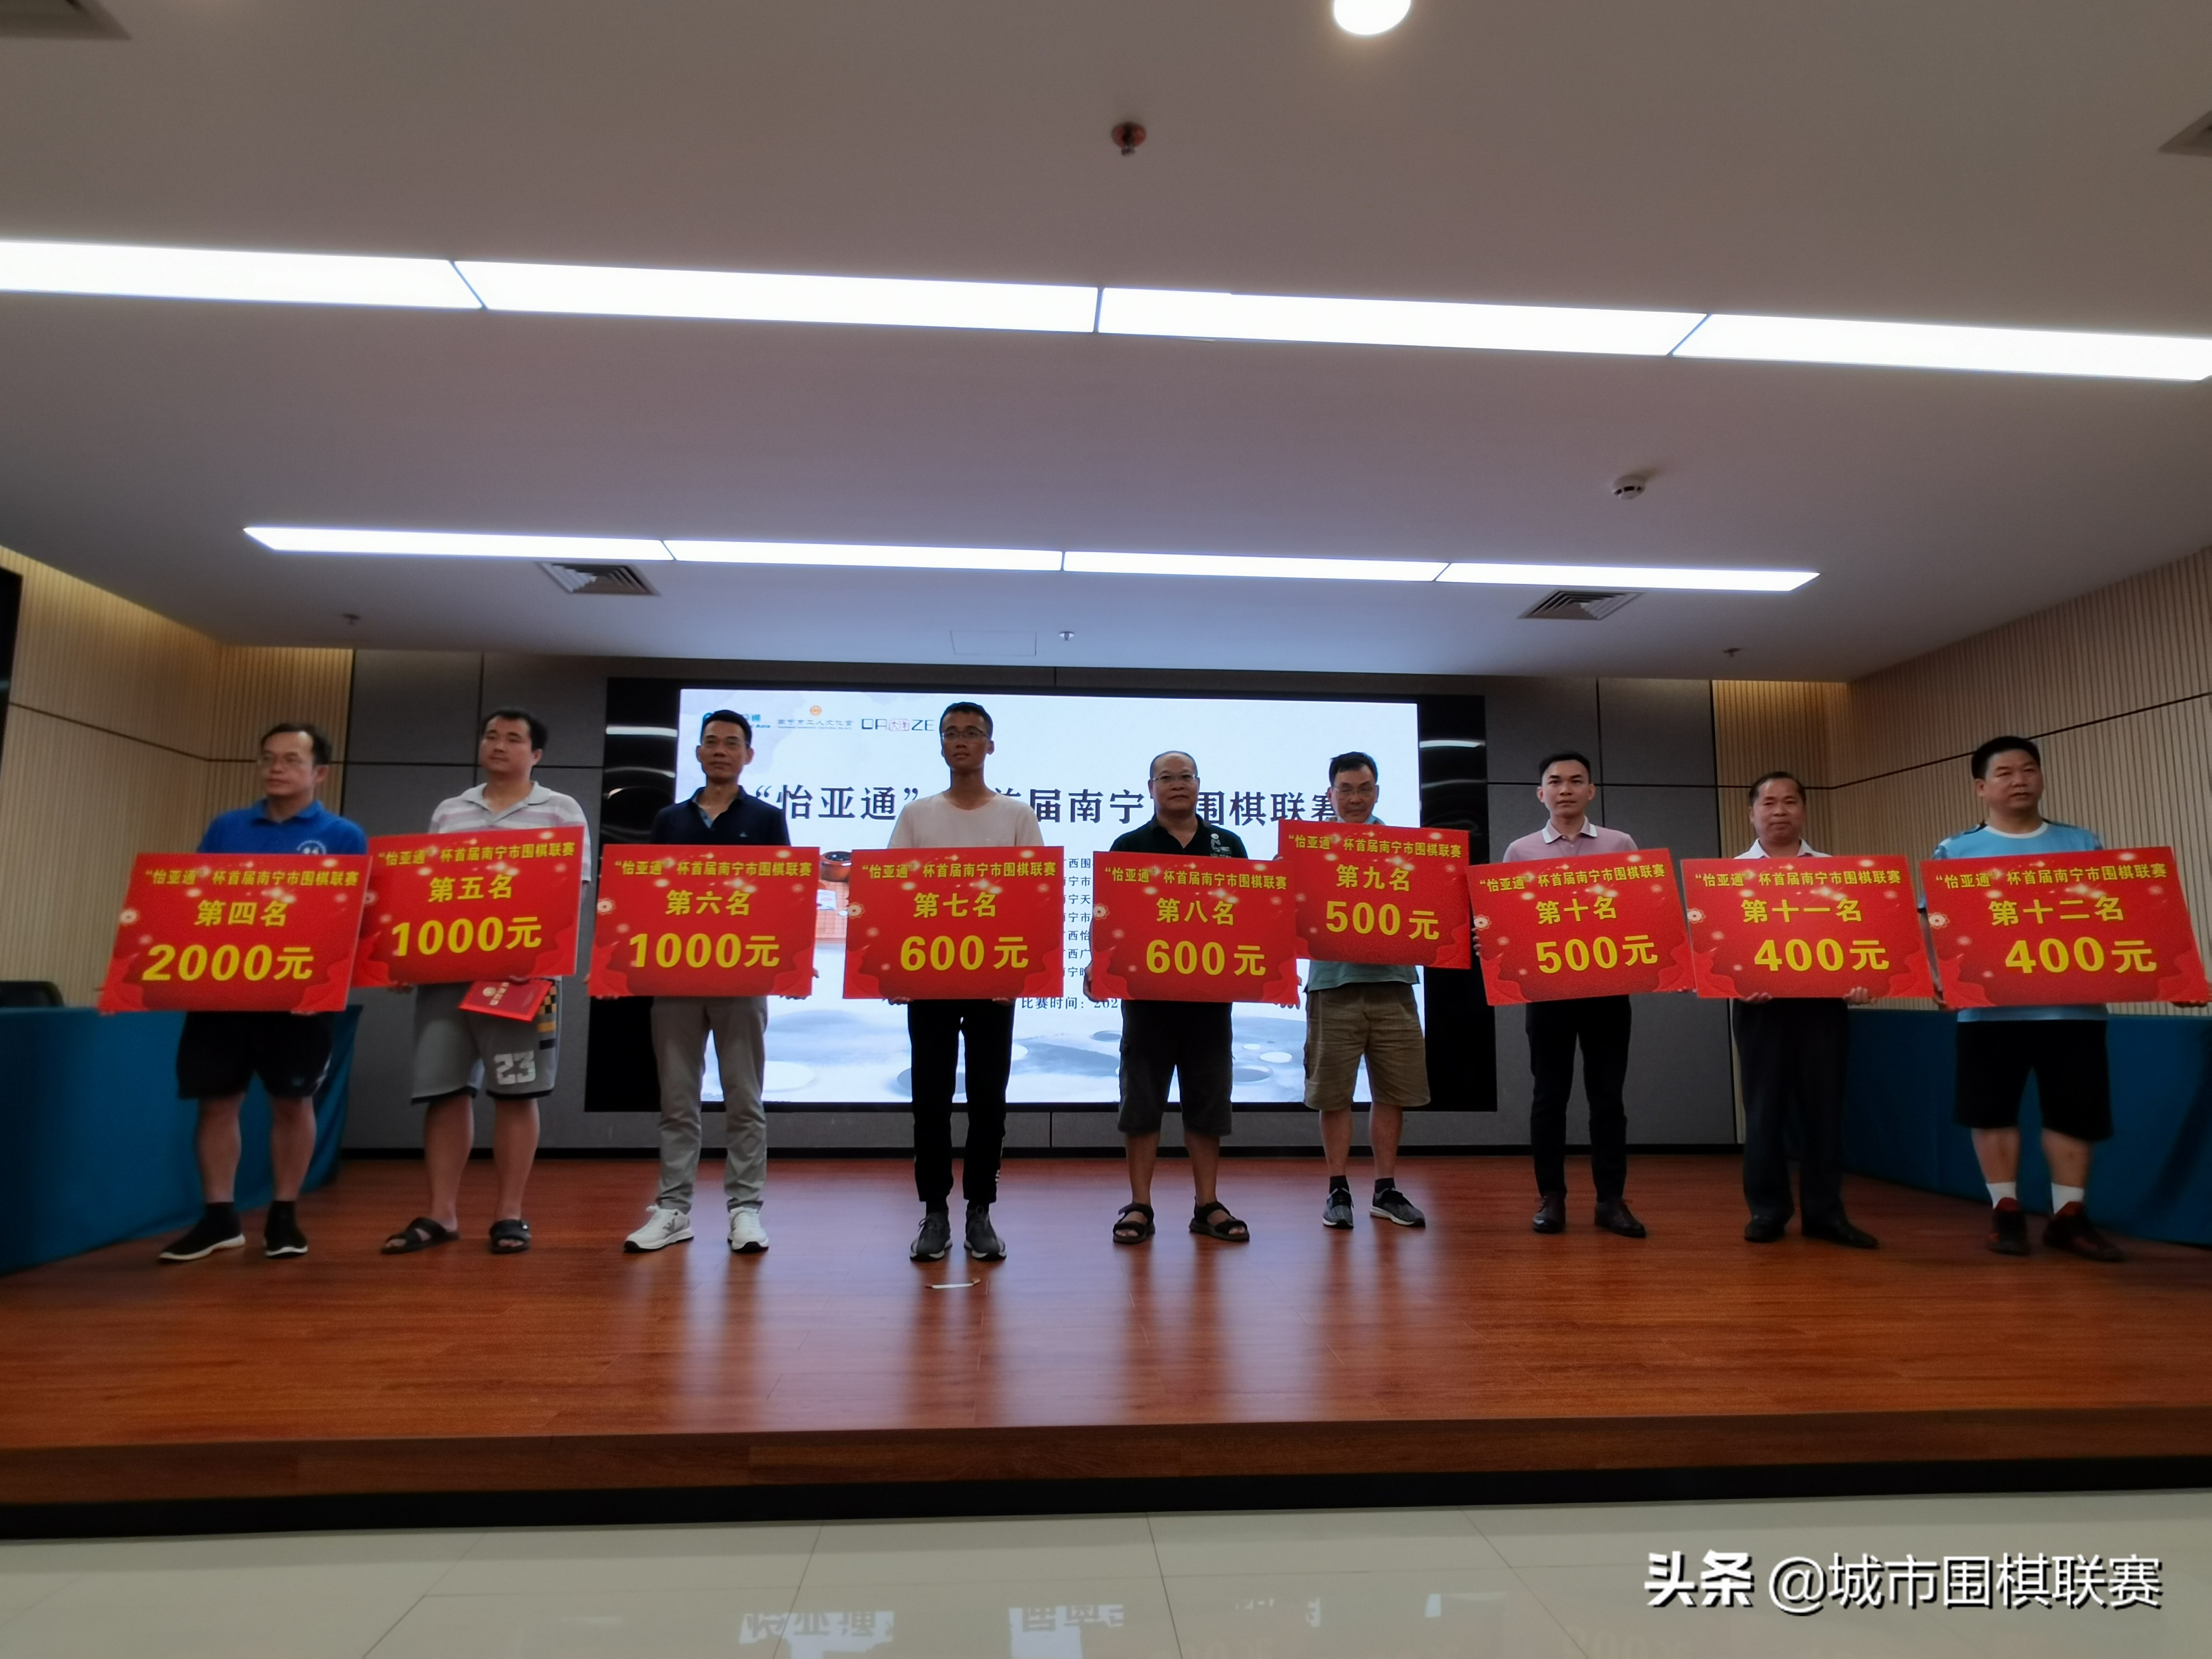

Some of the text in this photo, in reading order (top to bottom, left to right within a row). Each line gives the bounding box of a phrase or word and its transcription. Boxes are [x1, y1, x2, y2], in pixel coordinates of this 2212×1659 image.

[428, 874, 513, 902] 第五名
[1336, 865, 1410, 891] 第九名
[196, 900, 289, 926] 第四名
[665, 890, 750, 916] 第六名
[914, 891, 996, 918] 第七名
[1156, 898, 1234, 926] 第八名
[1536, 895, 1617, 924] 第十名
[1741, 898, 1862, 923] 第十一名
[1989, 894, 2123, 926] 第十二名
[393, 917, 542, 957] 1000元
[1326, 901, 1439, 940] 500元
[142, 945, 313, 981] 2000元
[630, 933, 780, 968] 1000元
[900, 936, 1028, 972] 600元
[1146, 940, 1266, 976] 600元
[1536, 935, 1658, 974] 500元
[1754, 939, 1889, 972] 400元
[2005, 937, 2157, 974] 400元
[494, 1050, 536, 1085] 23
